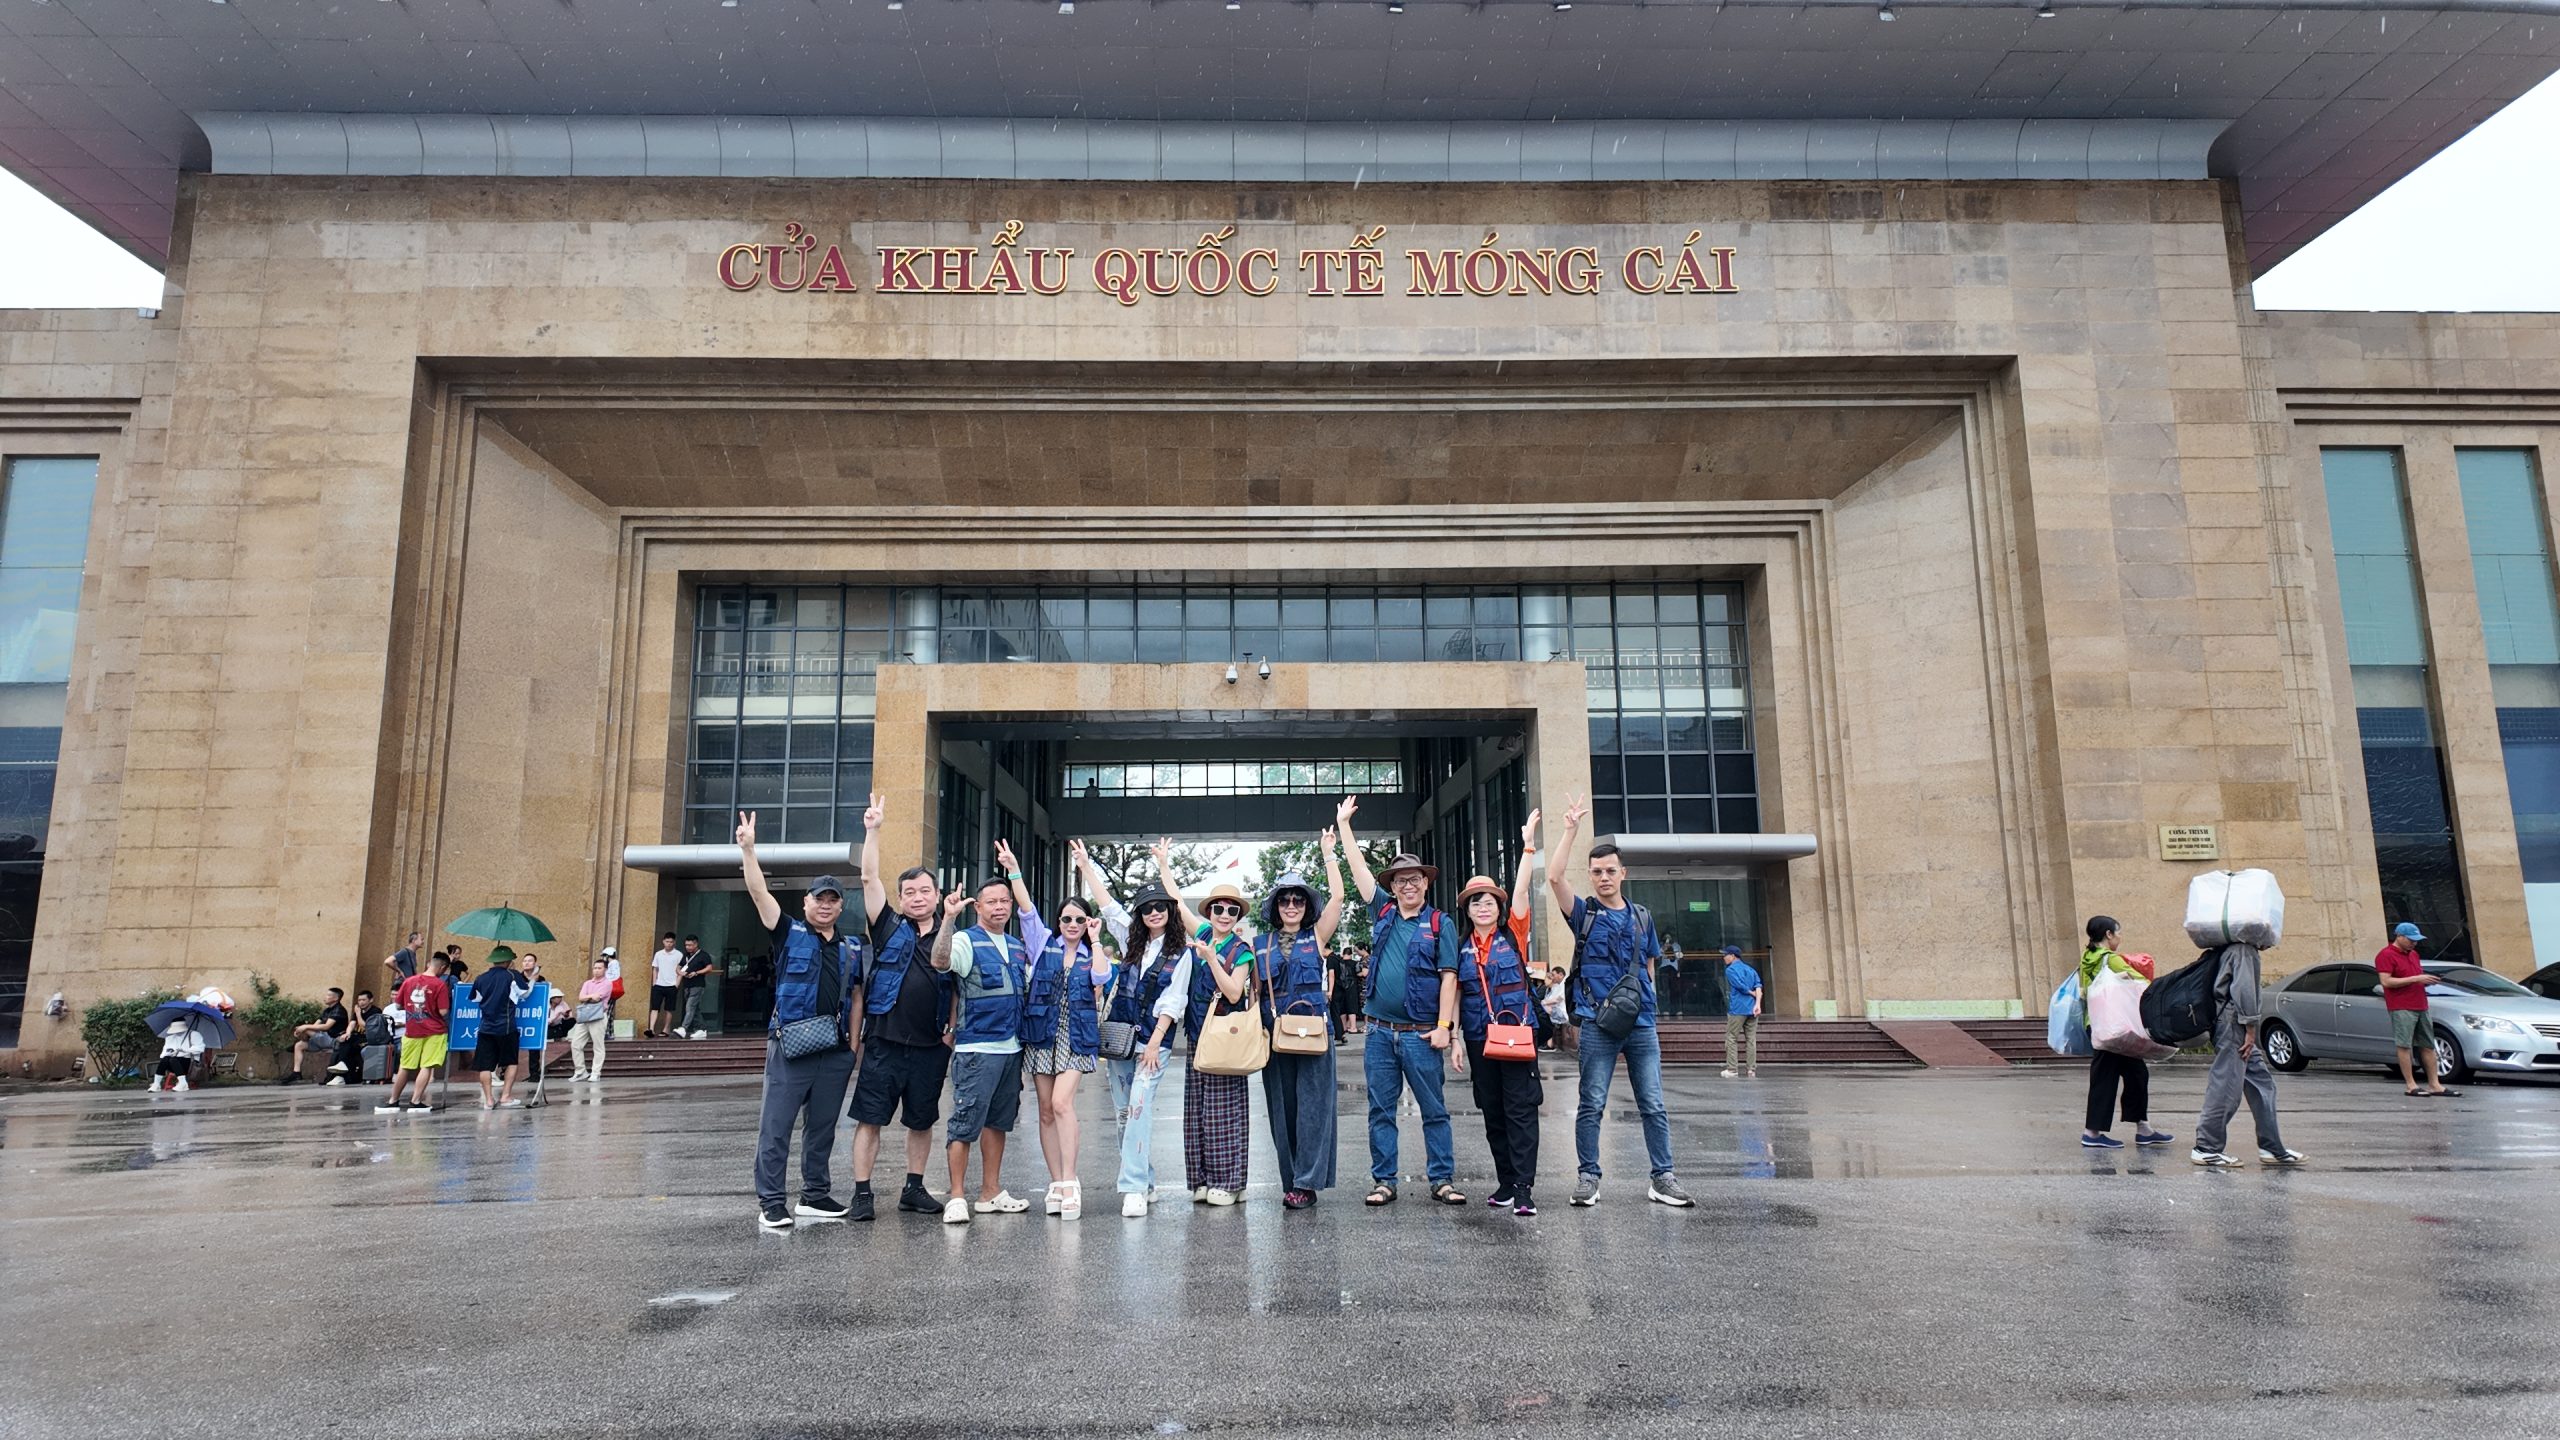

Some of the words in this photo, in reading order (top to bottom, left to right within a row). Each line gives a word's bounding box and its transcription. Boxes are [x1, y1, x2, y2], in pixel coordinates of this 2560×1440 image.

[717, 222, 858, 291] CỬA
[875, 219, 1075, 295] KHẨU
[1092, 225, 1280, 305] QUỐC
[1299, 224, 1387, 295] TẾ
[1405, 231, 1604, 295] MÓNG
[1622, 229, 1740, 294] CÁI
[532, 1006, 542, 1020] BỘ
